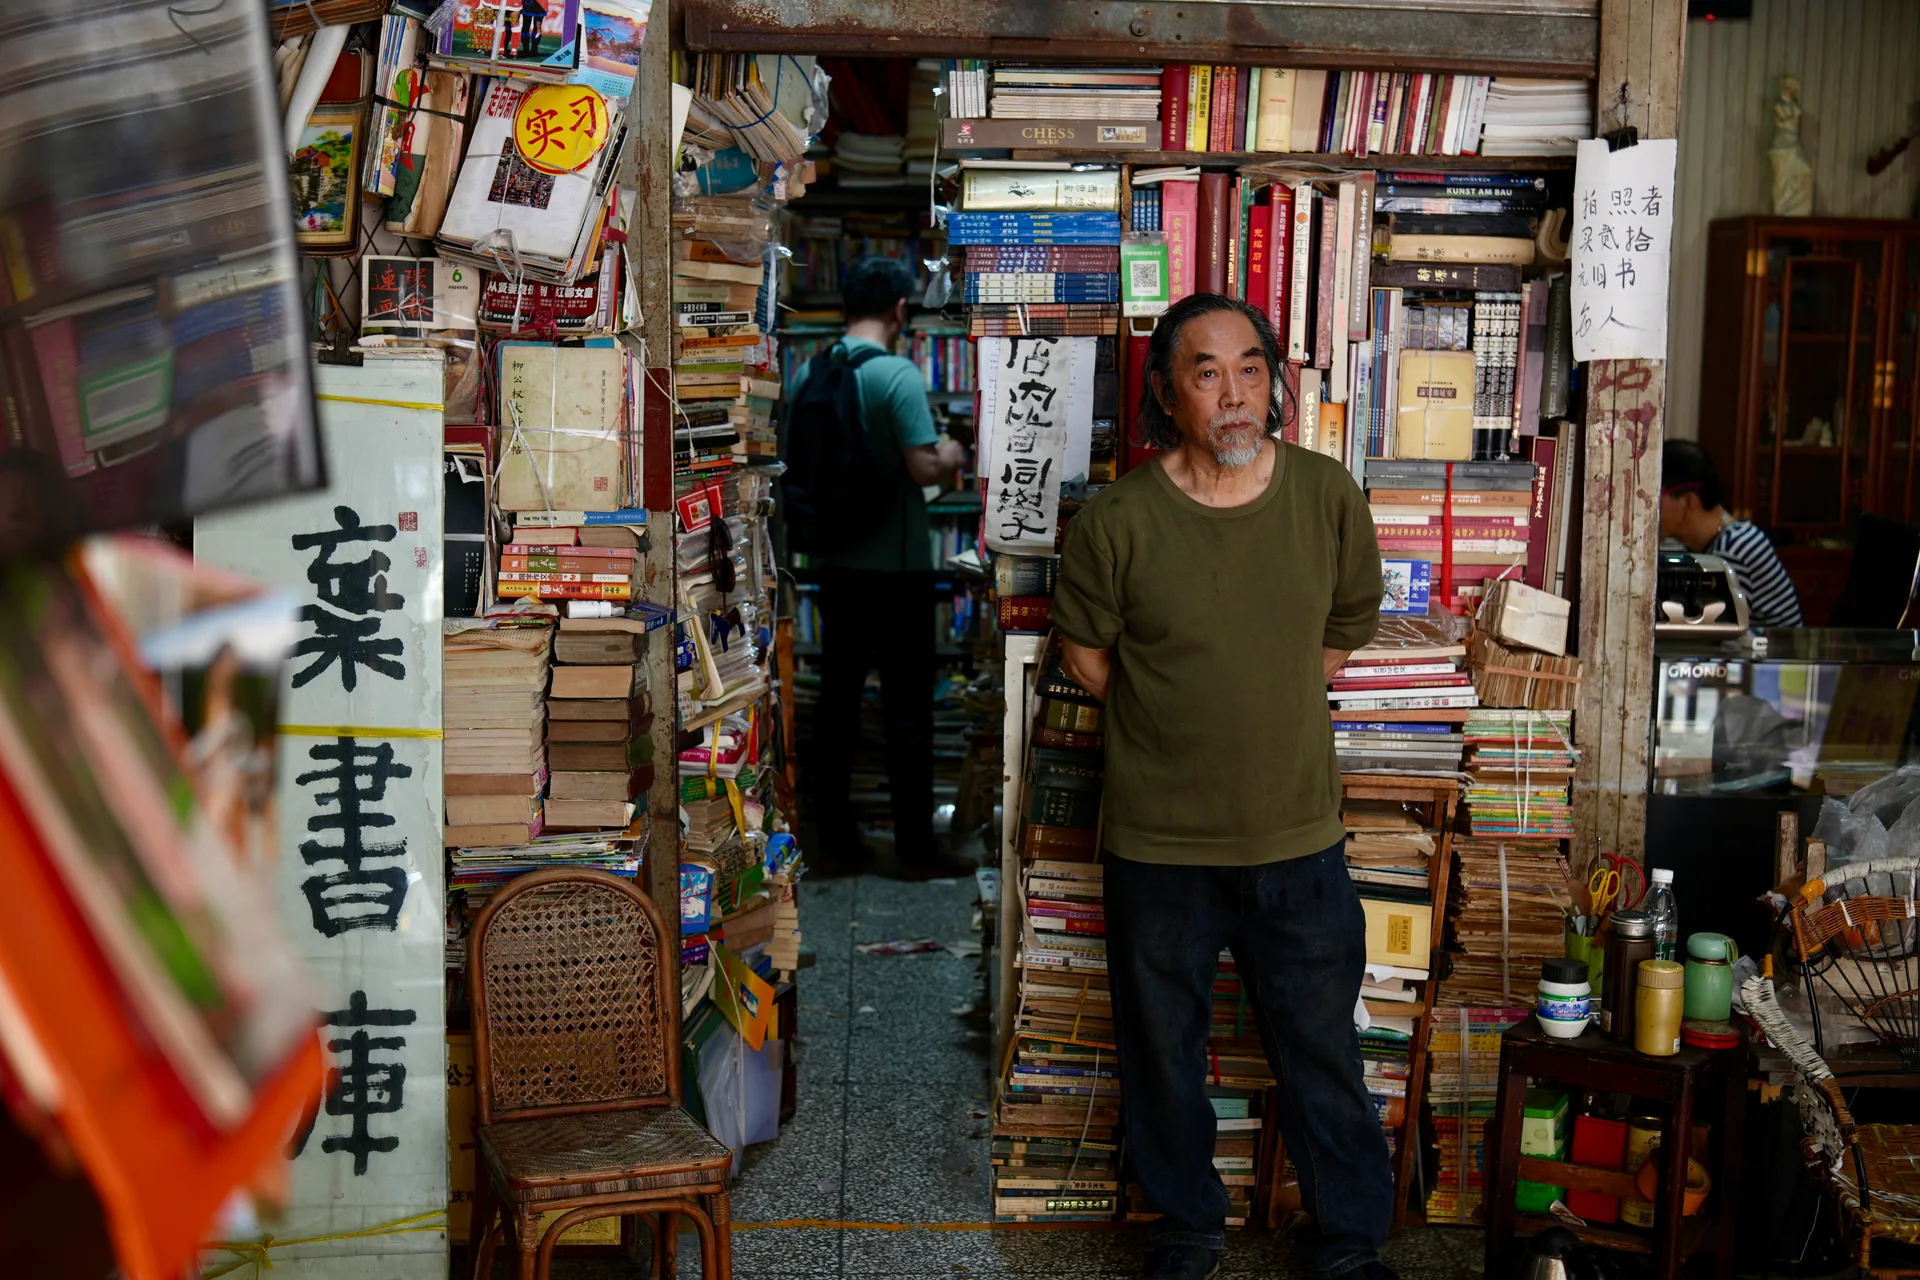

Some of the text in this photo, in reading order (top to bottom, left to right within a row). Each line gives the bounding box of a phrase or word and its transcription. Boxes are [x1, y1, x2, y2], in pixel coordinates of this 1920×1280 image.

[1274, 69, 1286, 79] 全
[525, 95, 597, 158] 实习
[1021, 127, 1076, 139] CHESS
[1446, 187, 1513, 197] KUNST AM BAU
[1582, 187, 1662, 219] 拍照者
[1252, 227, 1264, 274] 光辉历程
[1579, 225, 1654, 252] 买贰拾
[452, 269, 462, 283] 6
[1578, 258, 1637, 290] 元旧书
[1550, 283, 1564, 386] THE ERICSSON CHRONICLE
[1329, 420, 1338, 459] 世界名人
[1668, 665, 1726, 679] GMOND
